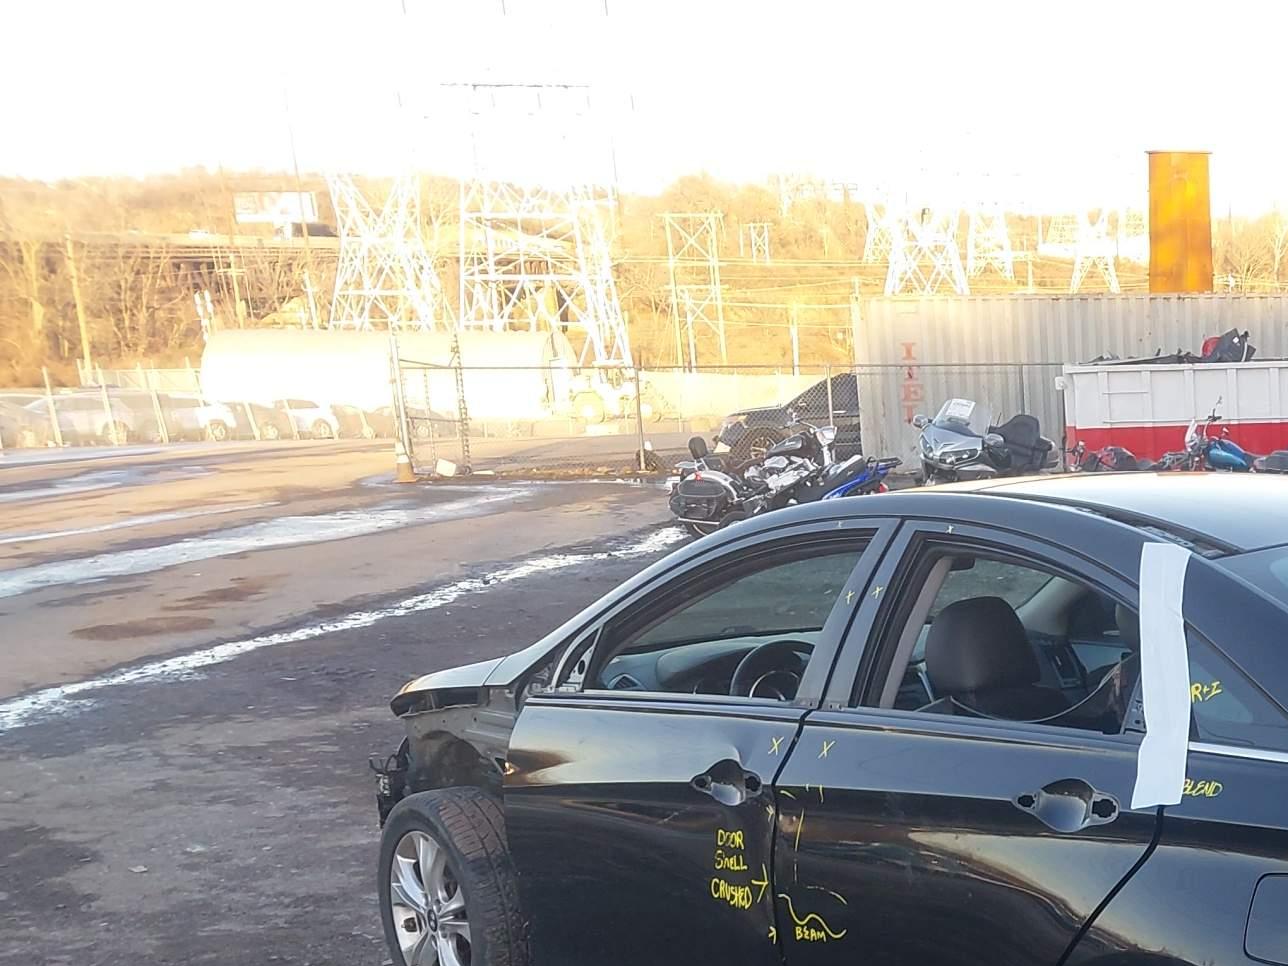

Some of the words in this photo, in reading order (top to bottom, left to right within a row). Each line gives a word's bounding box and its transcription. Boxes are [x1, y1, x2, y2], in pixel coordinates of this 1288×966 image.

[717, 829, 745, 850] DOOR
[711, 878, 752, 909] CRUSHED
[795, 926, 827, 942] BEAM
